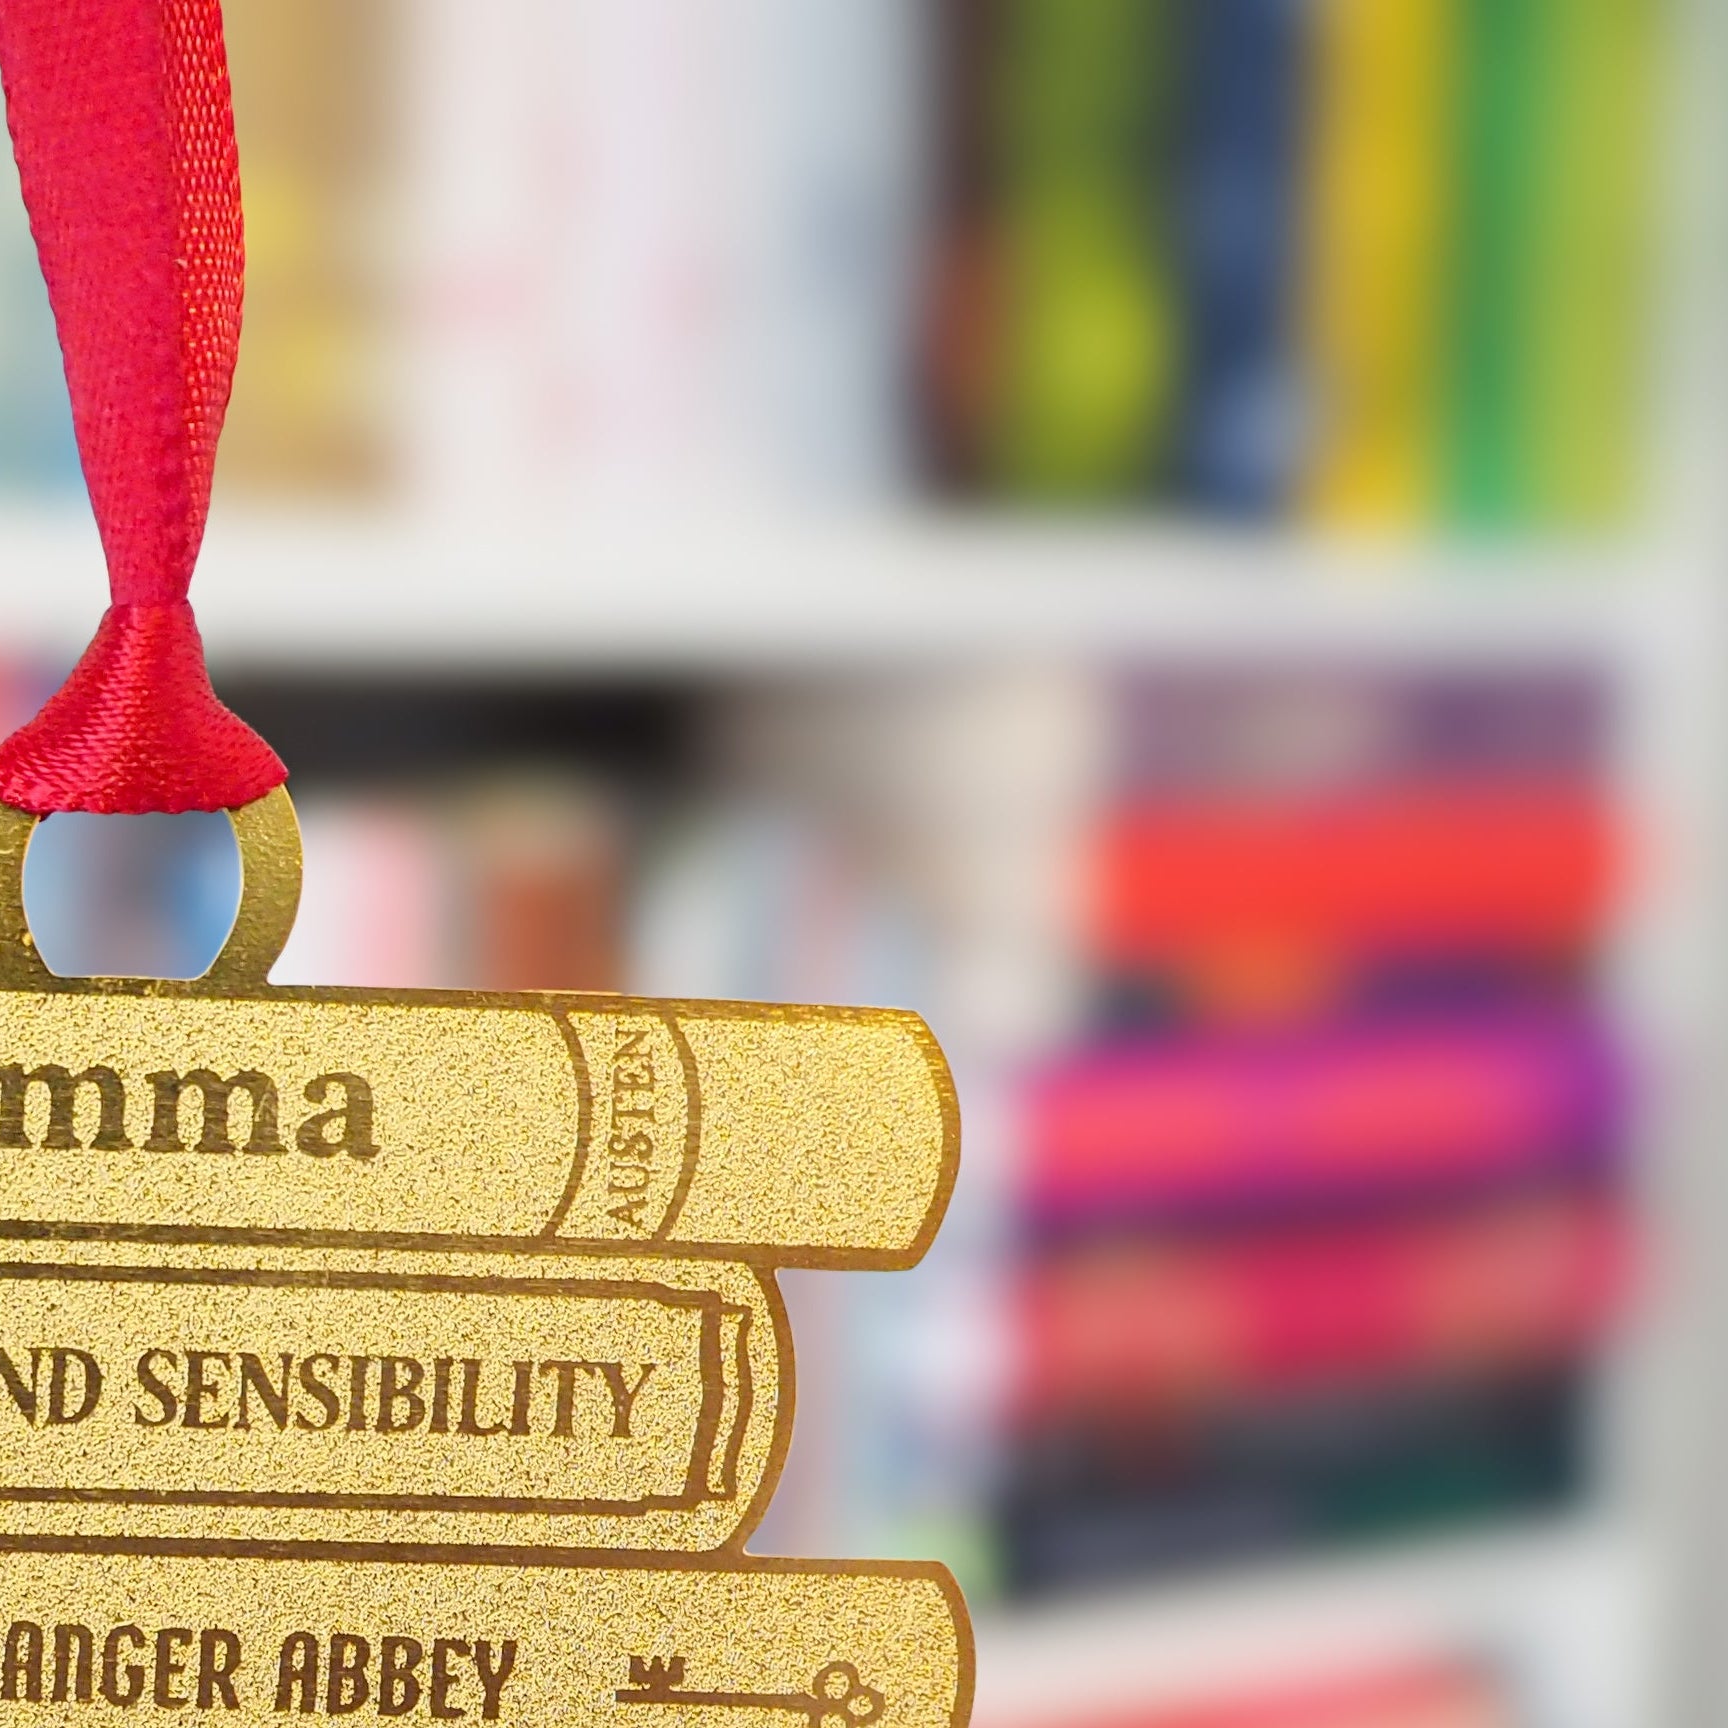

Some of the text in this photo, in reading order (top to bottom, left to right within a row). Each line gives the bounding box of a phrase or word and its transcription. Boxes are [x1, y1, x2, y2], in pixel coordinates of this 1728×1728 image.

[606, 1024, 660, 1227] AUSTEN
[133, 1348, 659, 1440] SENSIBILITY
[276, 1630, 519, 1722] ABBEY
